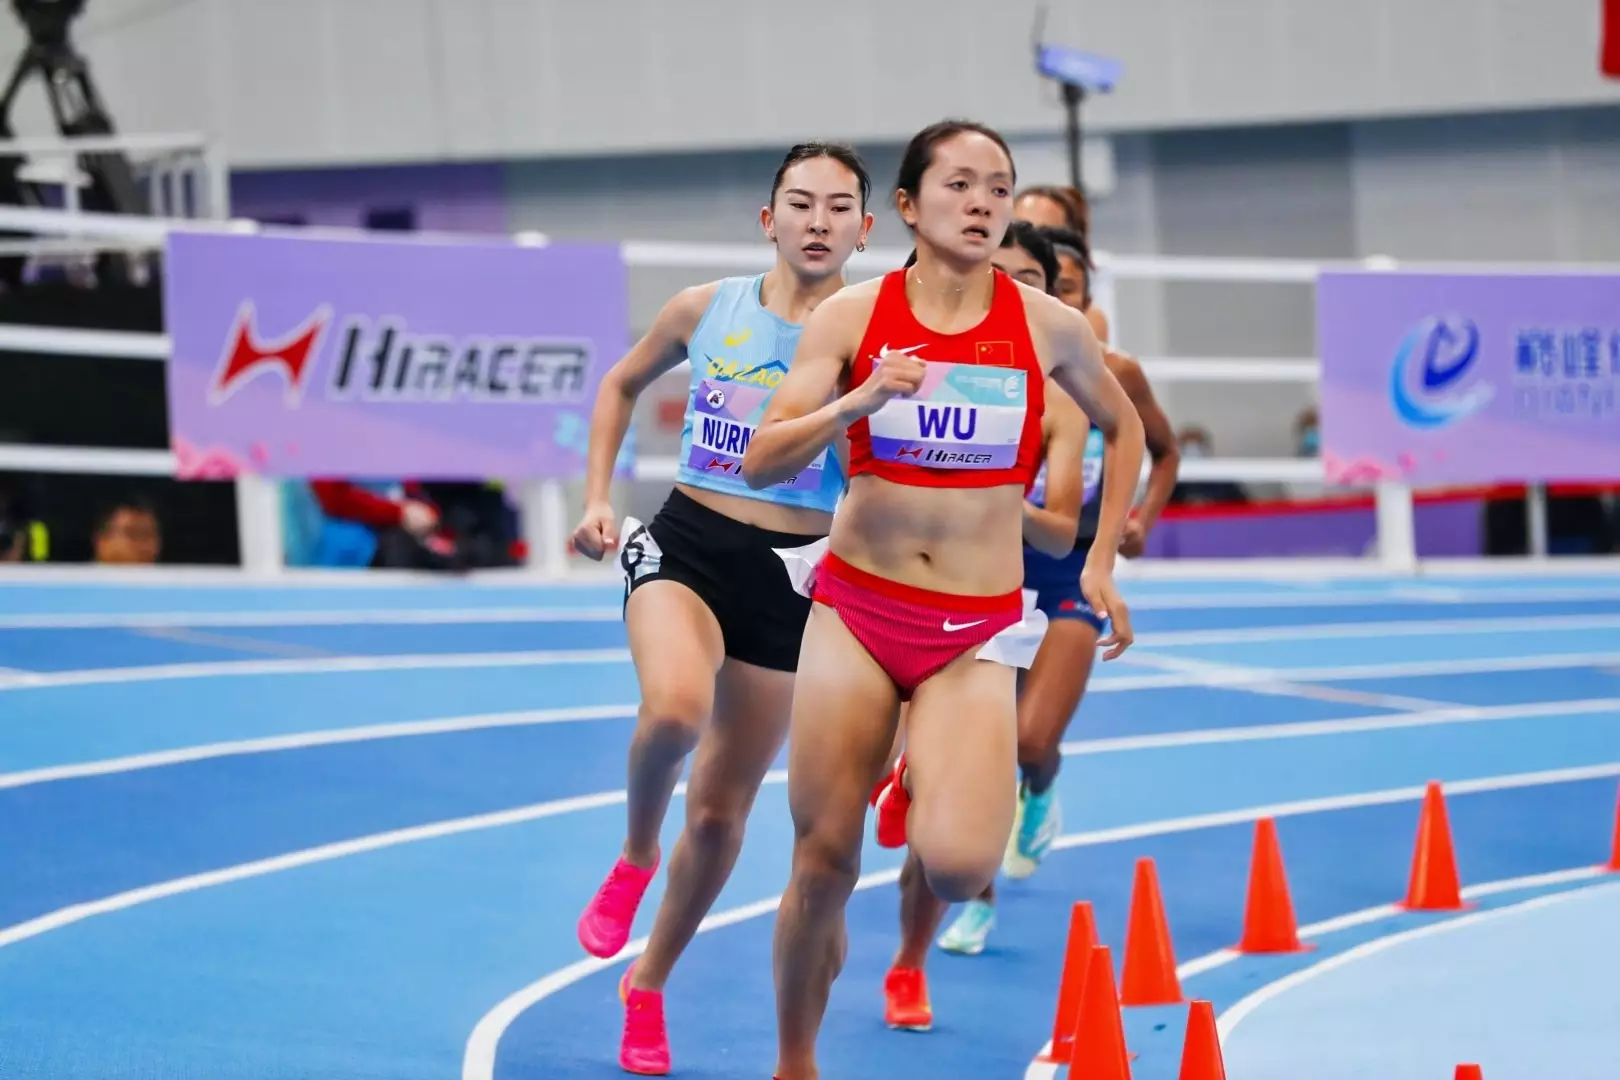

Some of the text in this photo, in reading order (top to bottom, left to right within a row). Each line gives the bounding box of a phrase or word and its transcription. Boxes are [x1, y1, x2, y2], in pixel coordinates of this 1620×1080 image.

[332, 320, 590, 397] HIRACER
[917, 404, 977, 441] WU
[925, 448, 993, 464] HIRACER
